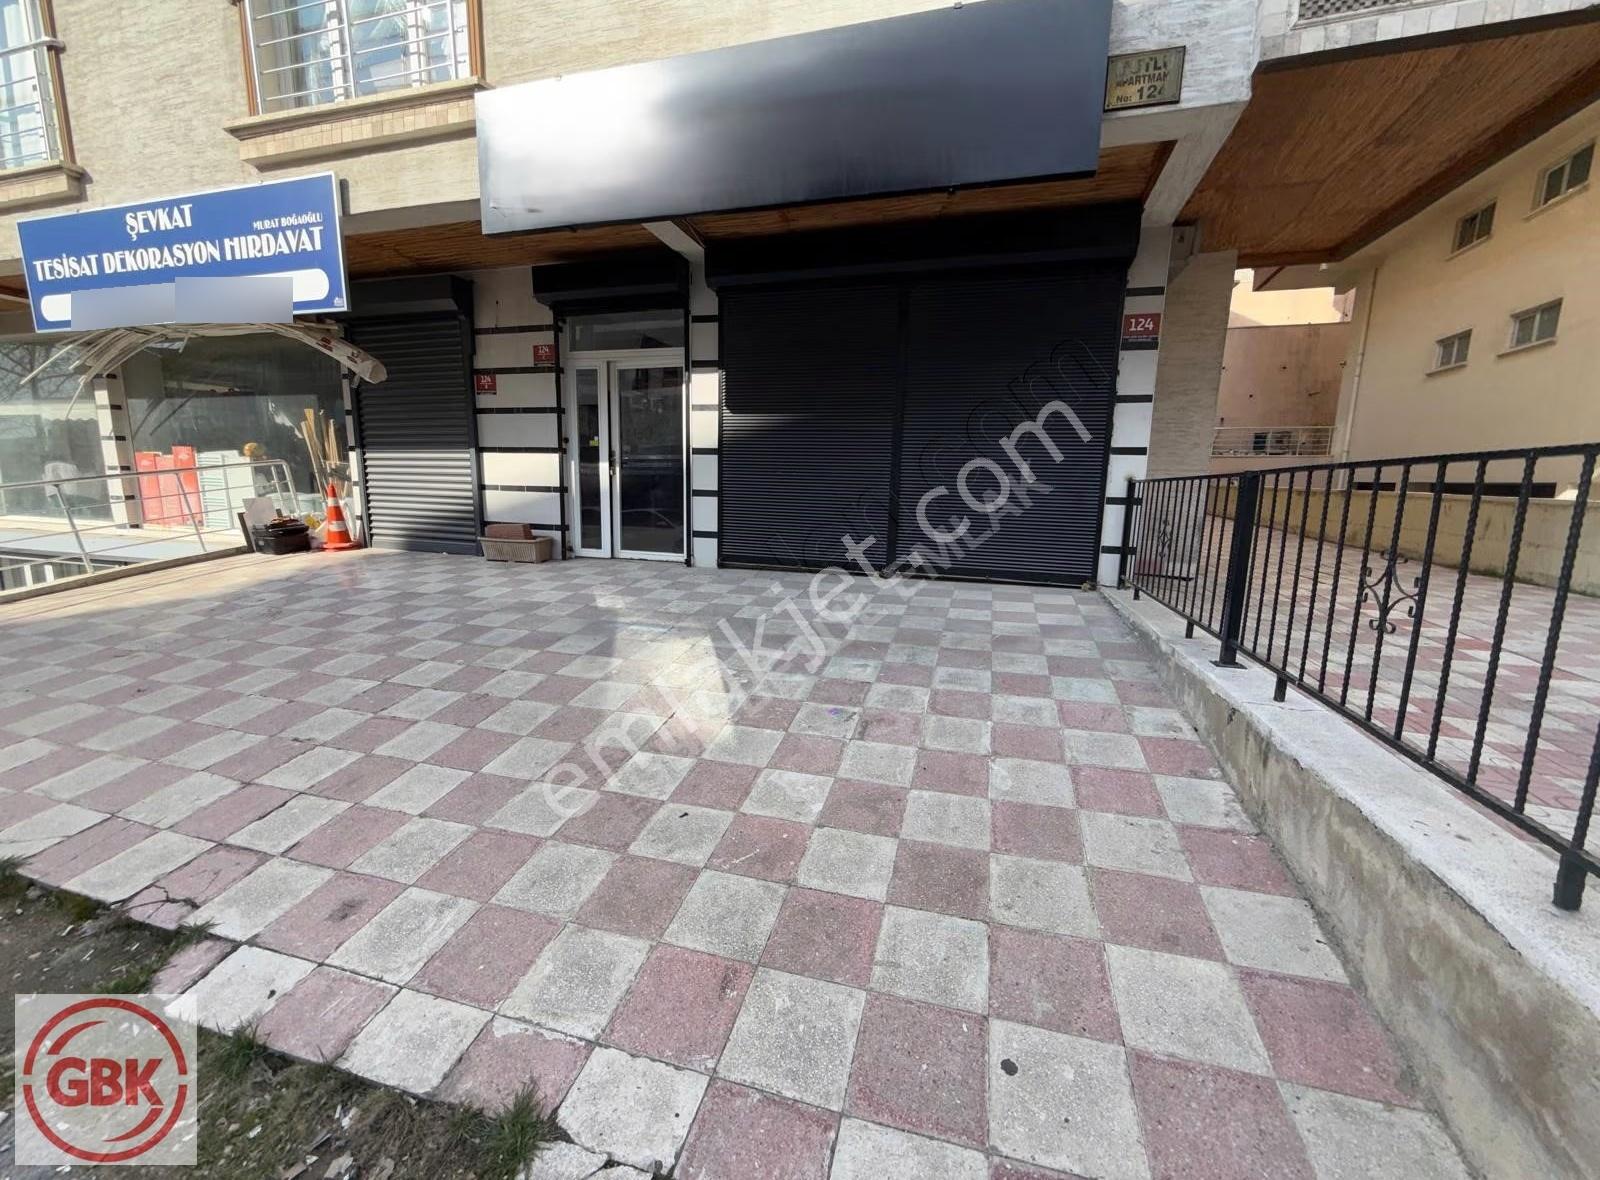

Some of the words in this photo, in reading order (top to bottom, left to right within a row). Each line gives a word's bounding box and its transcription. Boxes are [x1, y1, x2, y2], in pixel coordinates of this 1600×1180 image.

[125, 203, 193, 241] ŞEVKAT
[253, 218, 279, 231] MURAT
[33, 253, 99, 282] TESİSAT
[102, 239, 221, 274] DEKORASYON
[224, 226, 323, 261] HIRDAVAT
[1129, 318, 1154, 331] 124
